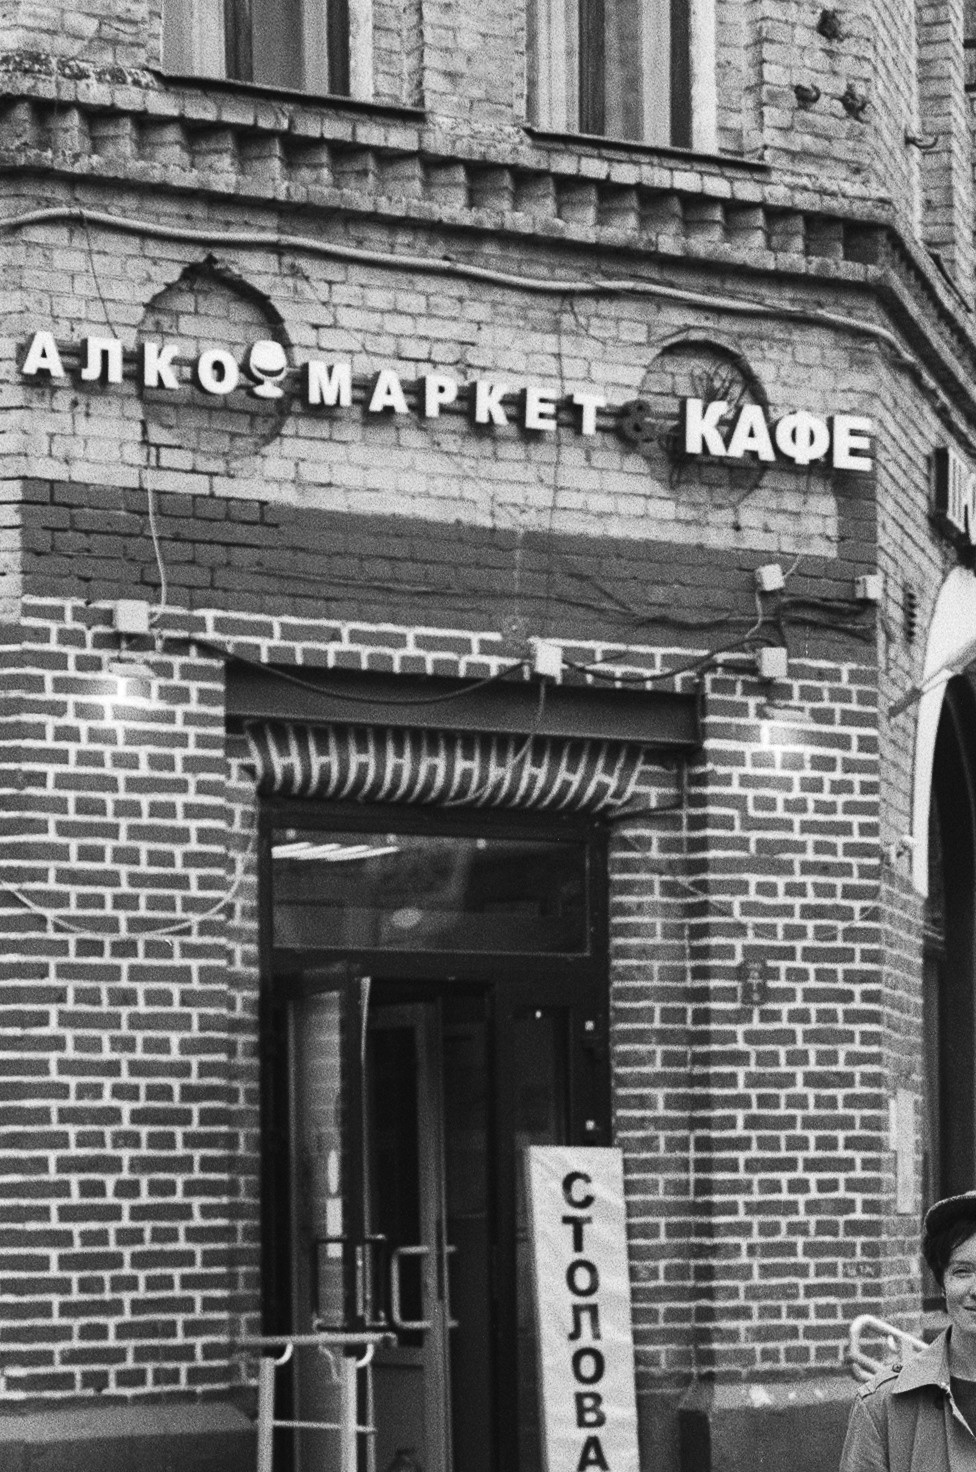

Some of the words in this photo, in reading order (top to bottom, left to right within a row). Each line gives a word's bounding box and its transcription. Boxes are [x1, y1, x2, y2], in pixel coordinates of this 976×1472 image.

[23, 330, 239, 394] АЛКО
[308, 359, 607, 435] МАРКЕТ
[686, 398, 872, 471] КАФЕ
